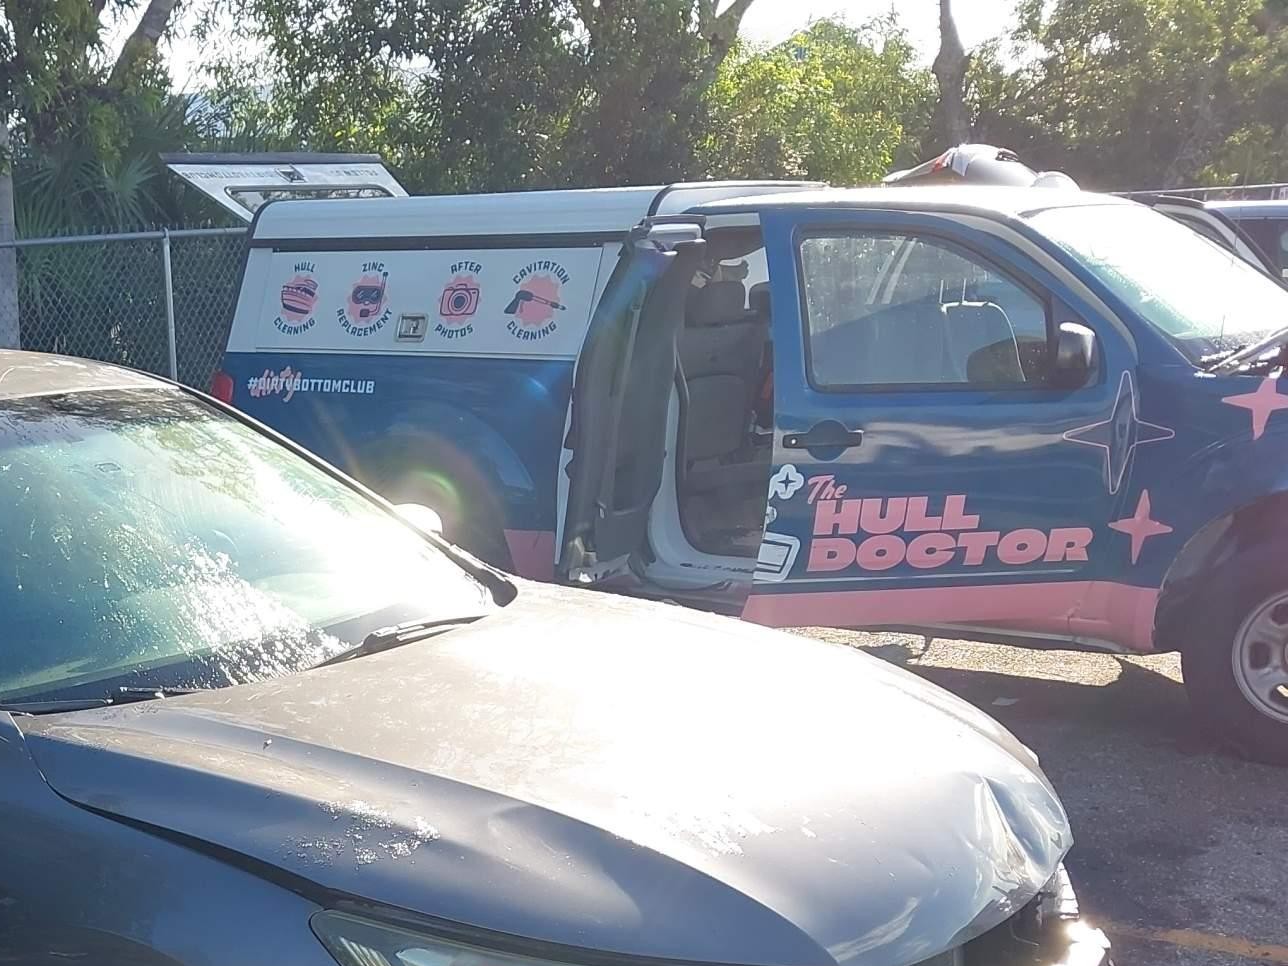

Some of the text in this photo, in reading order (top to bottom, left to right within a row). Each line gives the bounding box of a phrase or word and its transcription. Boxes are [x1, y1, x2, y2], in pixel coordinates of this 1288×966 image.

[294, 261, 315, 273] HULL
[362, 261, 385, 273] ZINC
[450, 260, 482, 275] AFTER
[512, 260, 570, 285] CAVITATION
[273, 316, 316, 336] CLEANING
[336, 307, 392, 337] REPLACEMENT
[435, 323, 474, 340] PHOTOS
[506, 320, 557, 342] CLEANING
[807, 474, 848, 505] The
[813, 494, 981, 535] HULL
[806, 526, 1094, 573] DOCTOR
